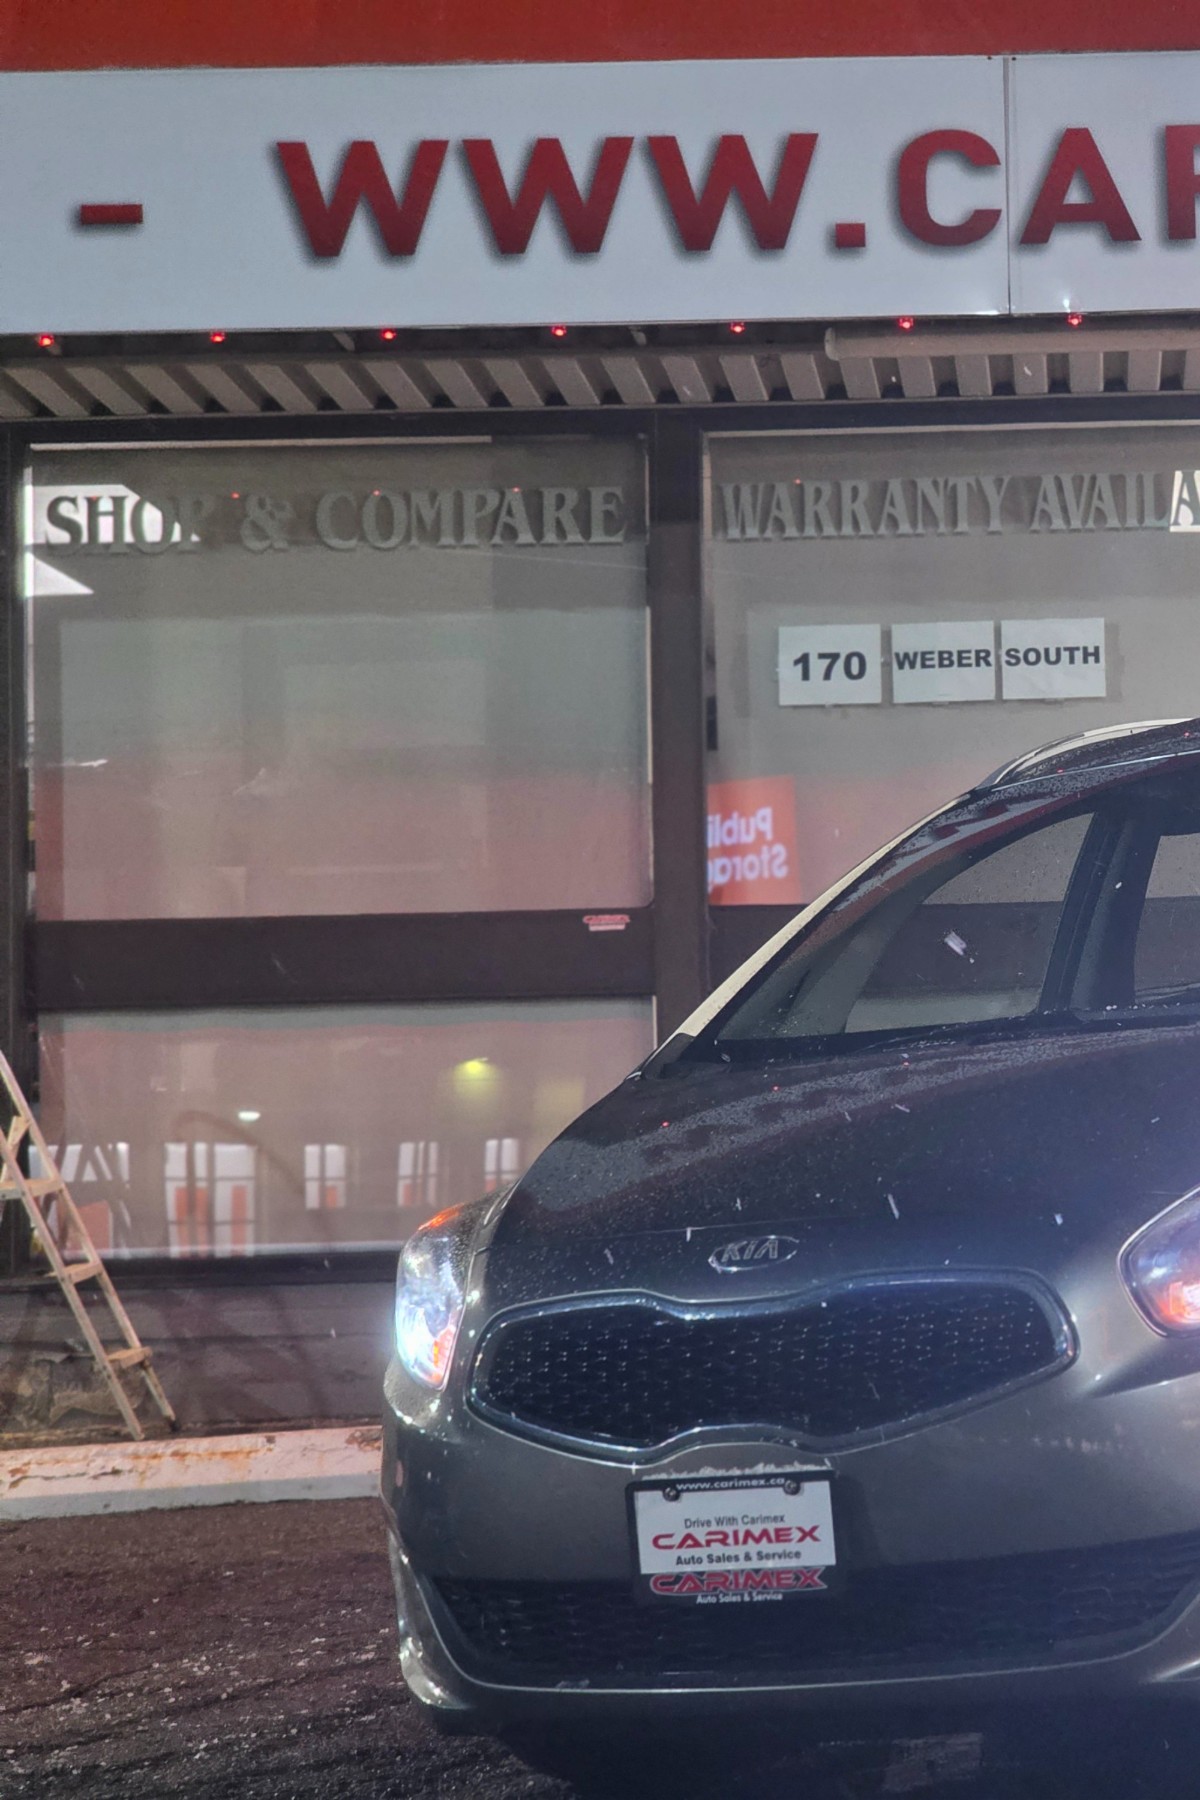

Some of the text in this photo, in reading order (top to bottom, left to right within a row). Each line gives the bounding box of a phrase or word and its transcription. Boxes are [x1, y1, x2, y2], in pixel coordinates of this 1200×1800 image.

[721, 475, 1006, 540] WARRANTY
[45, 486, 627, 554] SHOP & COMPARE
[792, 644, 1101, 682] 170 WEBER SOUTH
[721, 1240, 779, 1262] KIA
[676, 1477, 785, 1491] www.carimex.ca
[684, 1514, 785, 1529] Drive With Carimex
[652, 1525, 821, 1550] CARIMEX
[675, 1550, 802, 1566] Auto Sales & Service
[651, 1567, 826, 1593] CARIMEX
[696, 1591, 783, 1604] Auto Sales & Service
